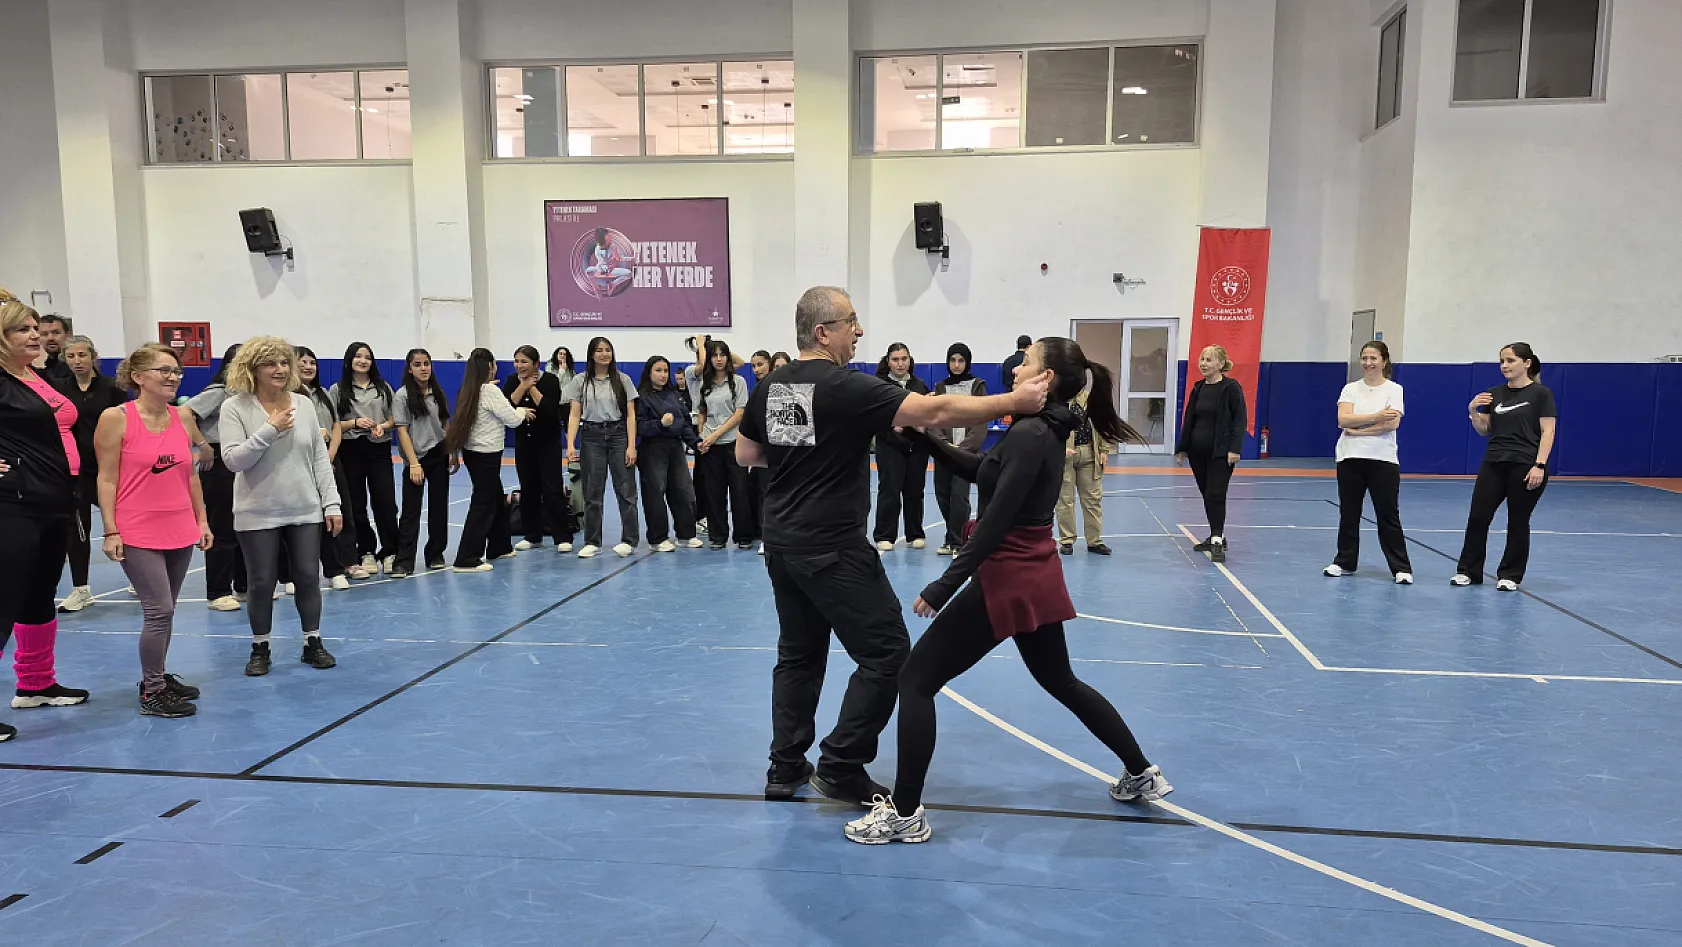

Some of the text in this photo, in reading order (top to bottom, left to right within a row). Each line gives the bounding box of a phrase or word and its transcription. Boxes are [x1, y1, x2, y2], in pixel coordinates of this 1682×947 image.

[632, 241, 697, 263] YETENEK
[632, 266, 714, 288] HER YERDE
[1216, 307, 1243, 315] GENÇLİK
[781, 402, 793, 411] THE
[156, 454, 175, 465] NIKE
